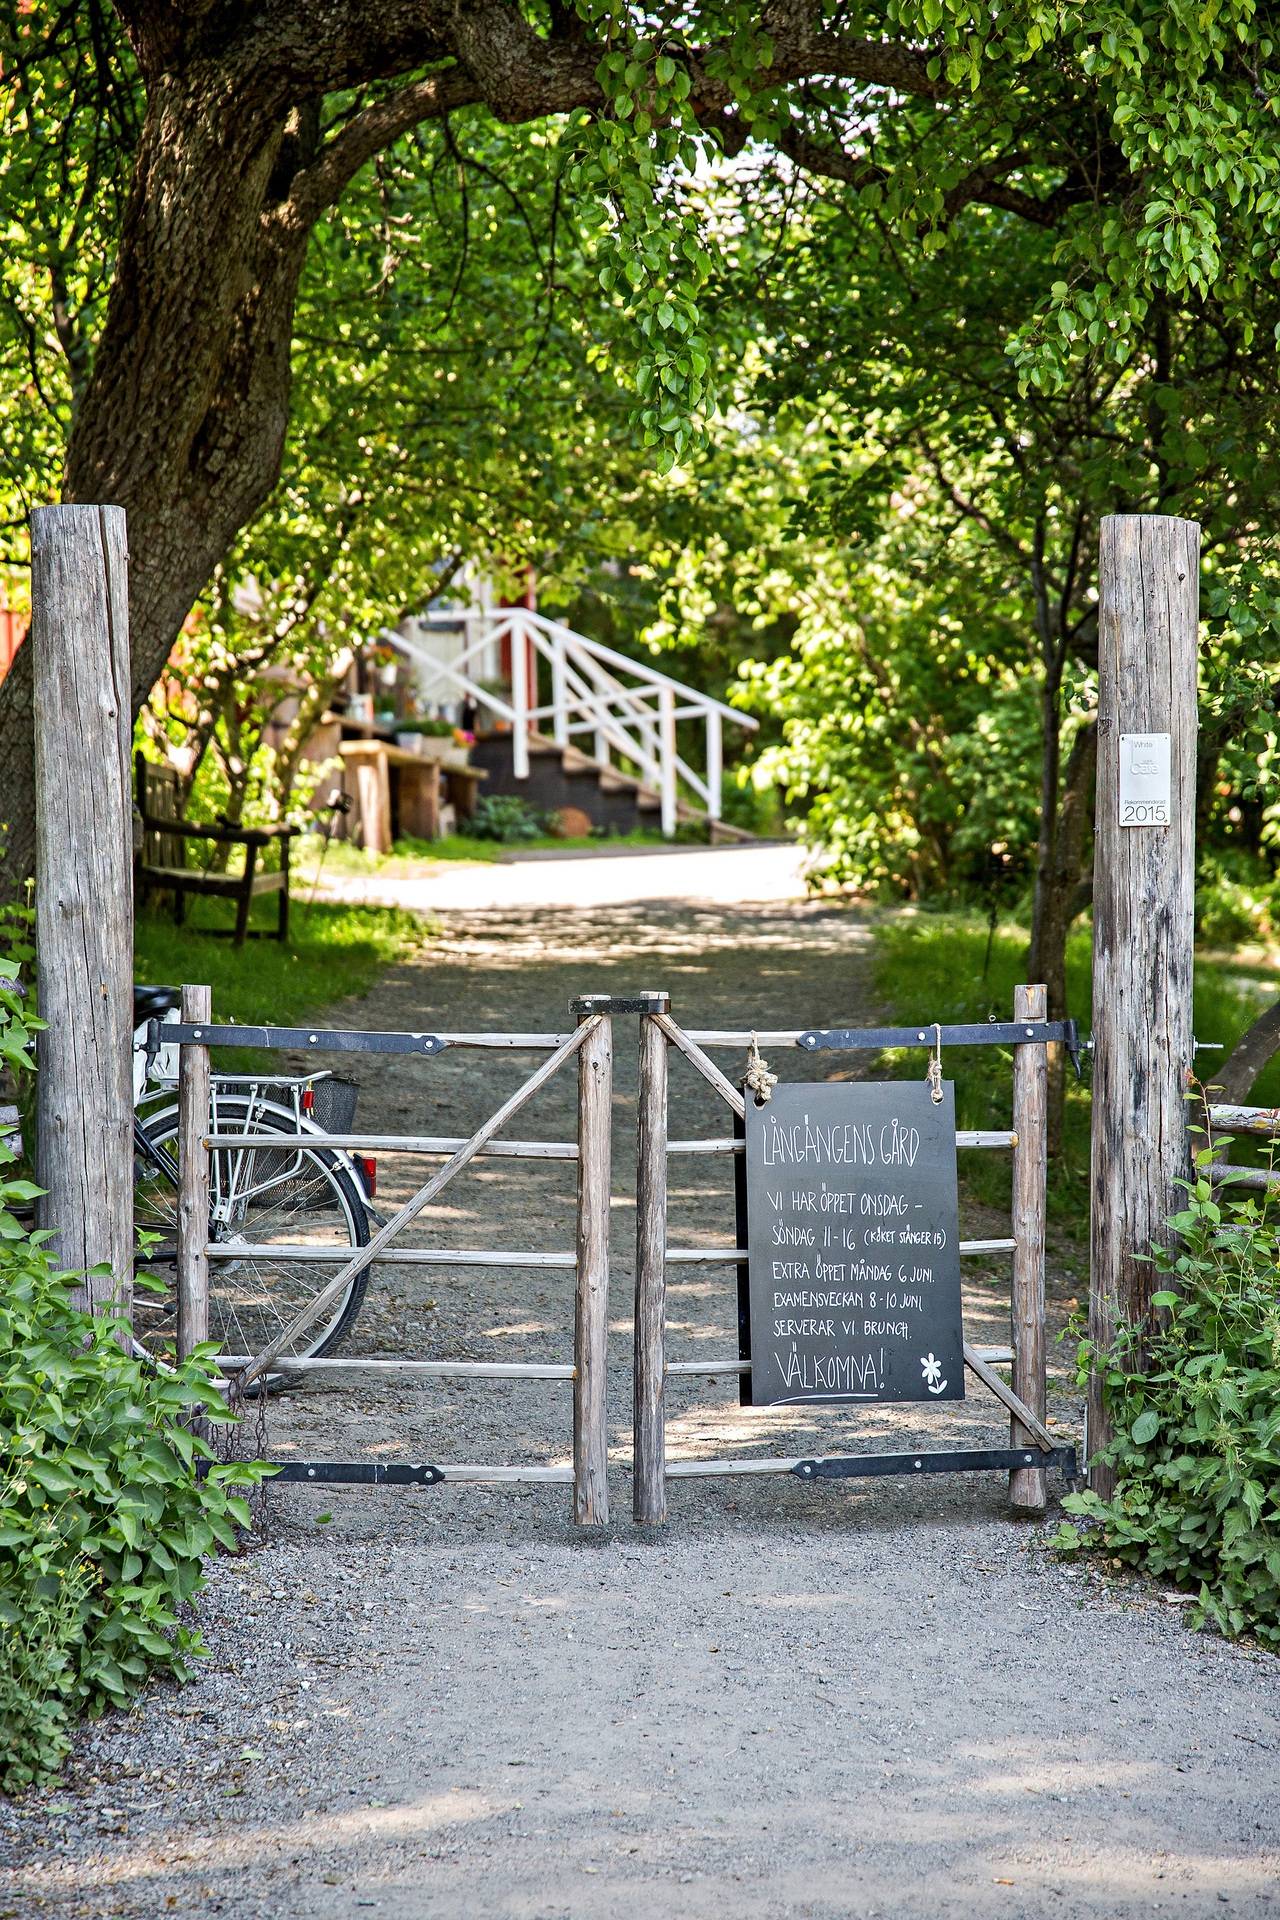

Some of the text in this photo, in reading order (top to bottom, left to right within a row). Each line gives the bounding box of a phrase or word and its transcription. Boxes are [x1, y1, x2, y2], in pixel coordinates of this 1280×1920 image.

[1124, 805, 1166, 822] 2015
[880, 1118, 920, 1167] GÅRD
[767, 1191, 783, 1210] VI
[792, 1191, 818, 1212] HAR
[820, 1182, 856, 1214] ÖPPET
[860, 1193, 908, 1216] ONSDAG
[772, 1218, 816, 1246] SÖNDAG
[772, 1254, 935, 1283] EXTRA ÖPPET MÅNDAG 6 JUNI.
[773, 1290, 863, 1309] EXAMENSVECKAN
[900, 1293, 923, 1312] JUNI
[773, 1319, 835, 1337] SERVERAR
[774, 1341, 885, 1390] VÄLKOMNA!
